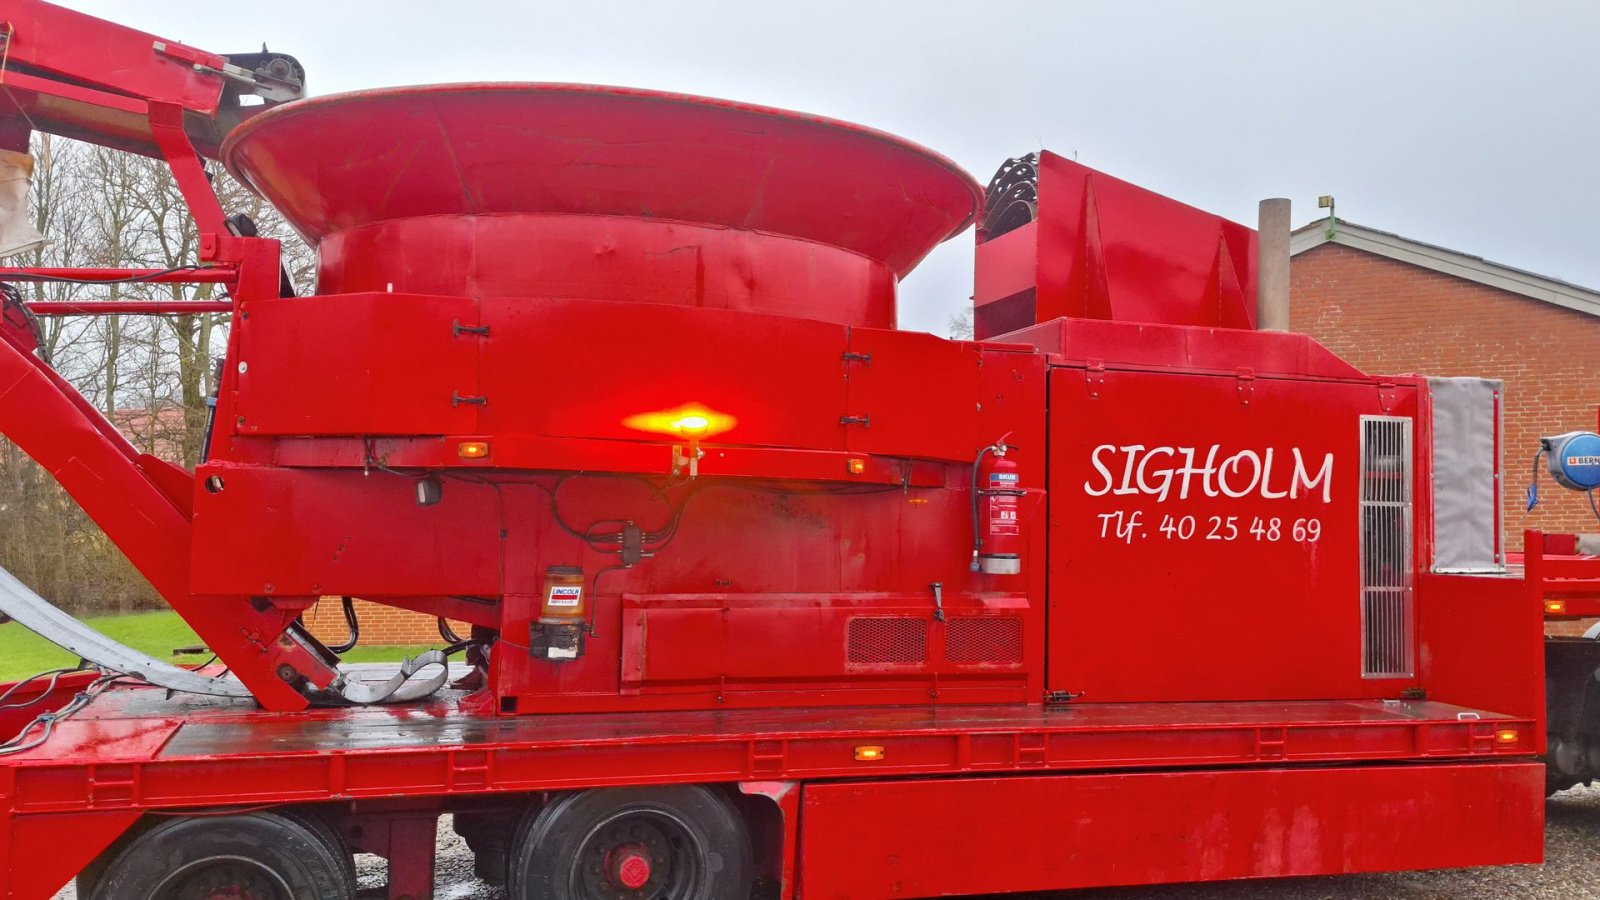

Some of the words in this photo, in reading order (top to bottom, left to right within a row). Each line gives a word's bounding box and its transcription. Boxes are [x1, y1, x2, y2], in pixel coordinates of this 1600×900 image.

[1084, 444, 1334, 503] SIGHOLM
[1097, 511, 1148, 544] Tlf.
[1159, 515, 1196, 540] 40
[1206, 516, 1238, 540] 25
[1249, 516, 1281, 541] 48
[1292, 518, 1321, 542] 69
